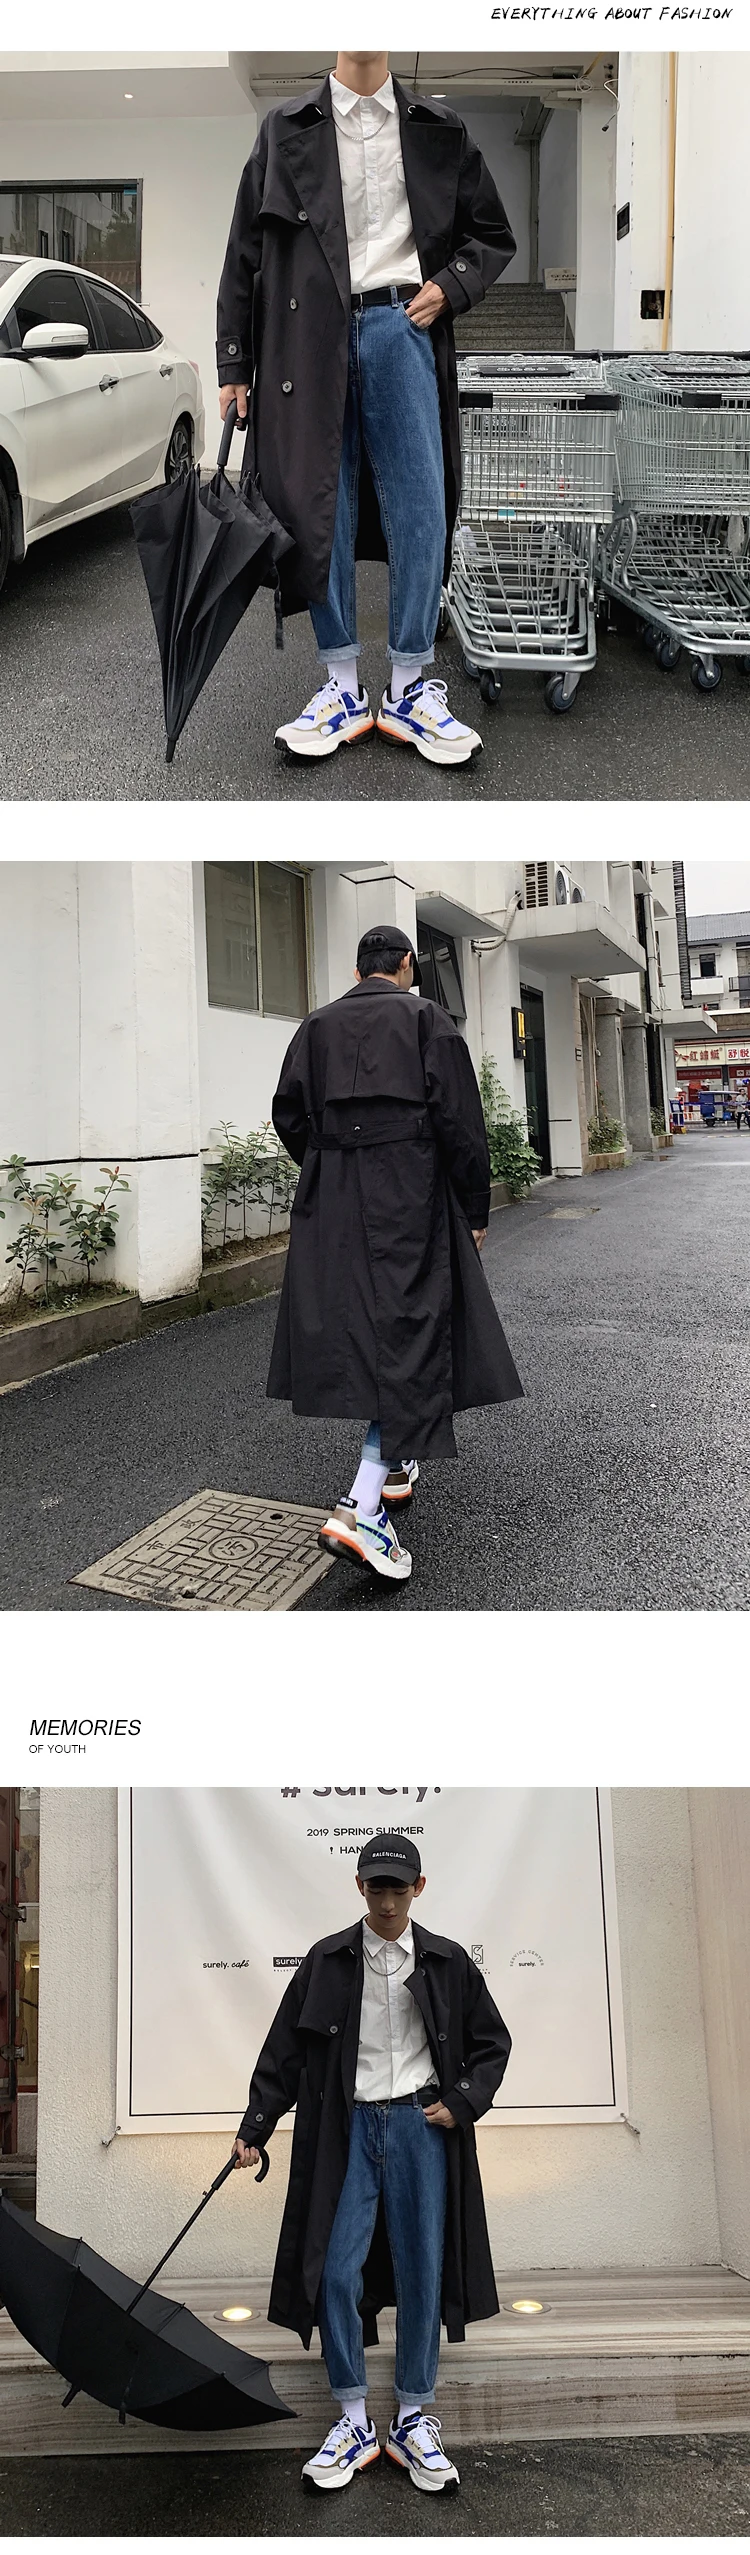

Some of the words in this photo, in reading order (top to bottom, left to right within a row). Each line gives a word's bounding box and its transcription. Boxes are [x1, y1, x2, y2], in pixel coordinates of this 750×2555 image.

[306, 1828, 330, 1837] 2019
[333, 1827, 374, 1837] SPRING
[376, 1826, 424, 1836] SUMMER
[372, 1851, 407, 1860] BALENCIAGA
[203, 1961, 230, 1970] surely.
[231, 1960, 250, 1969] café
